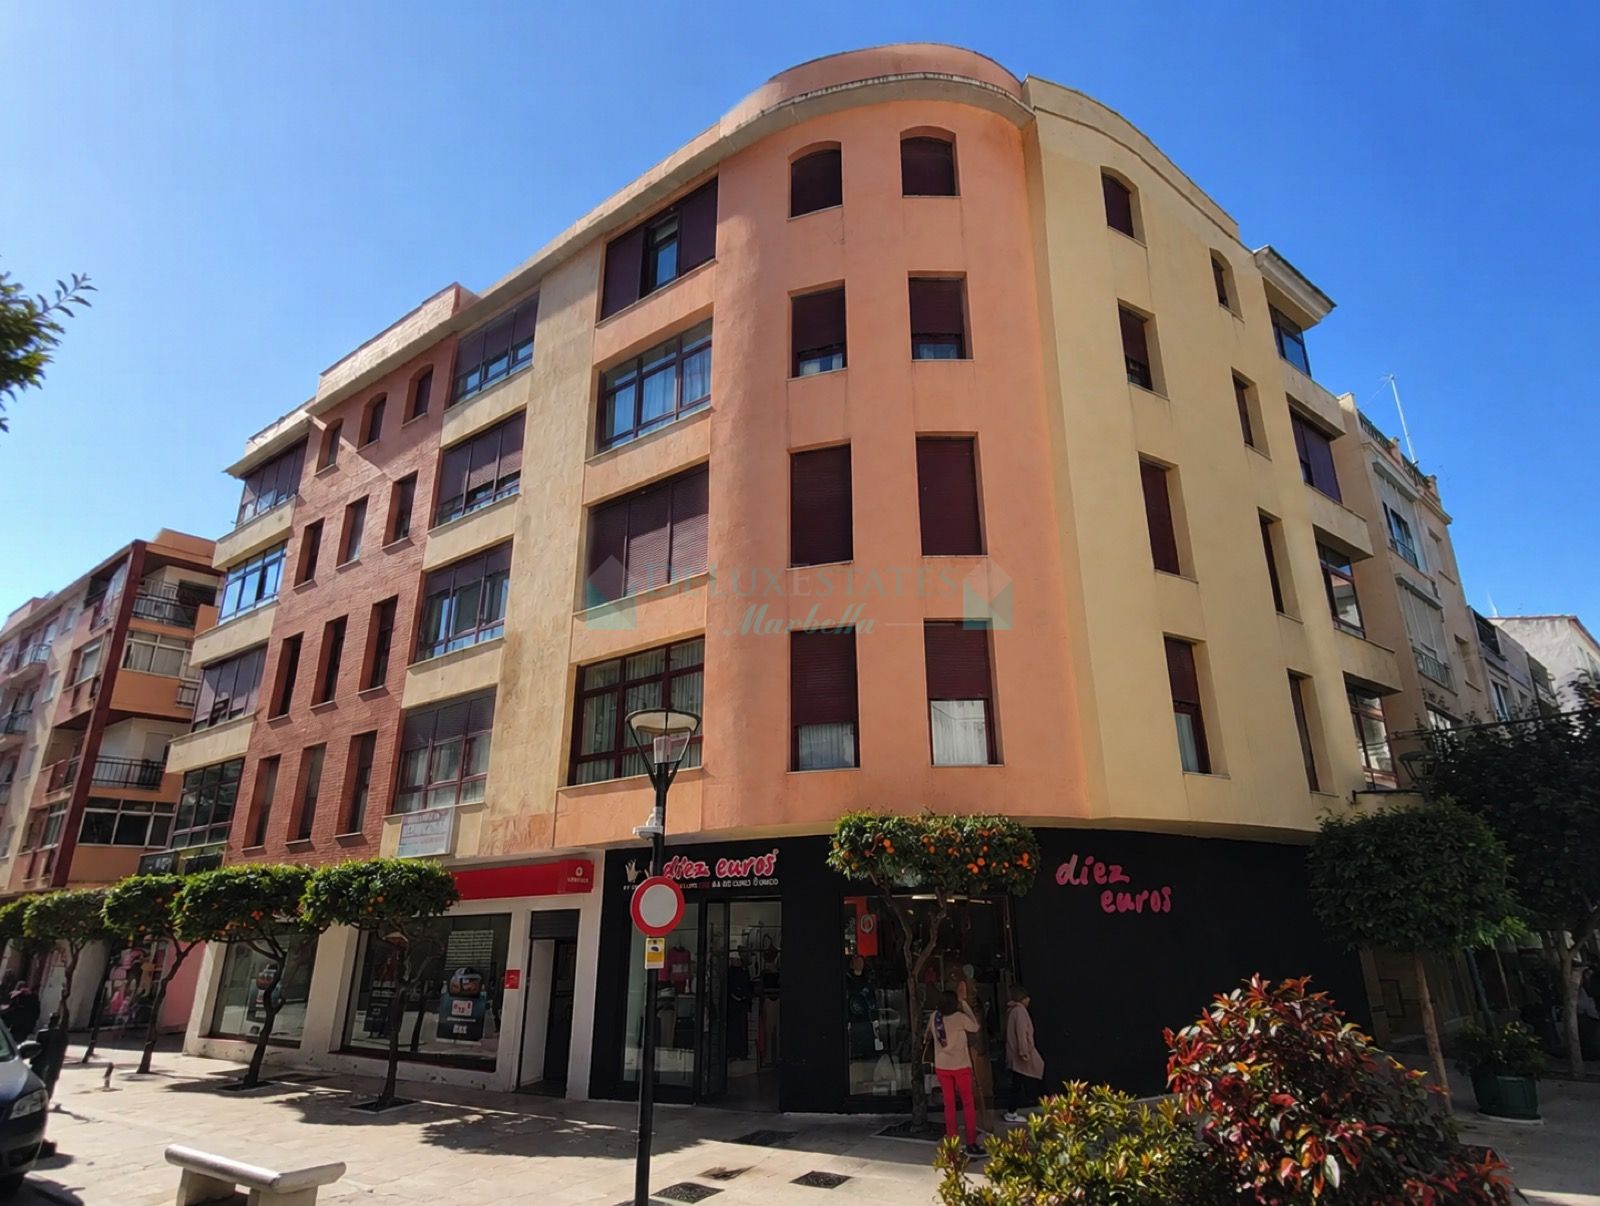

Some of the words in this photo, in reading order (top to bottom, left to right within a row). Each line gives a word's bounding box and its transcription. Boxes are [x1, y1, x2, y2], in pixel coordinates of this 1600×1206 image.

[663, 855, 710, 879] diez
[715, 853, 776, 878] euros
[1055, 853, 1130, 886] diez
[1100, 886, 1172, 913] euros
